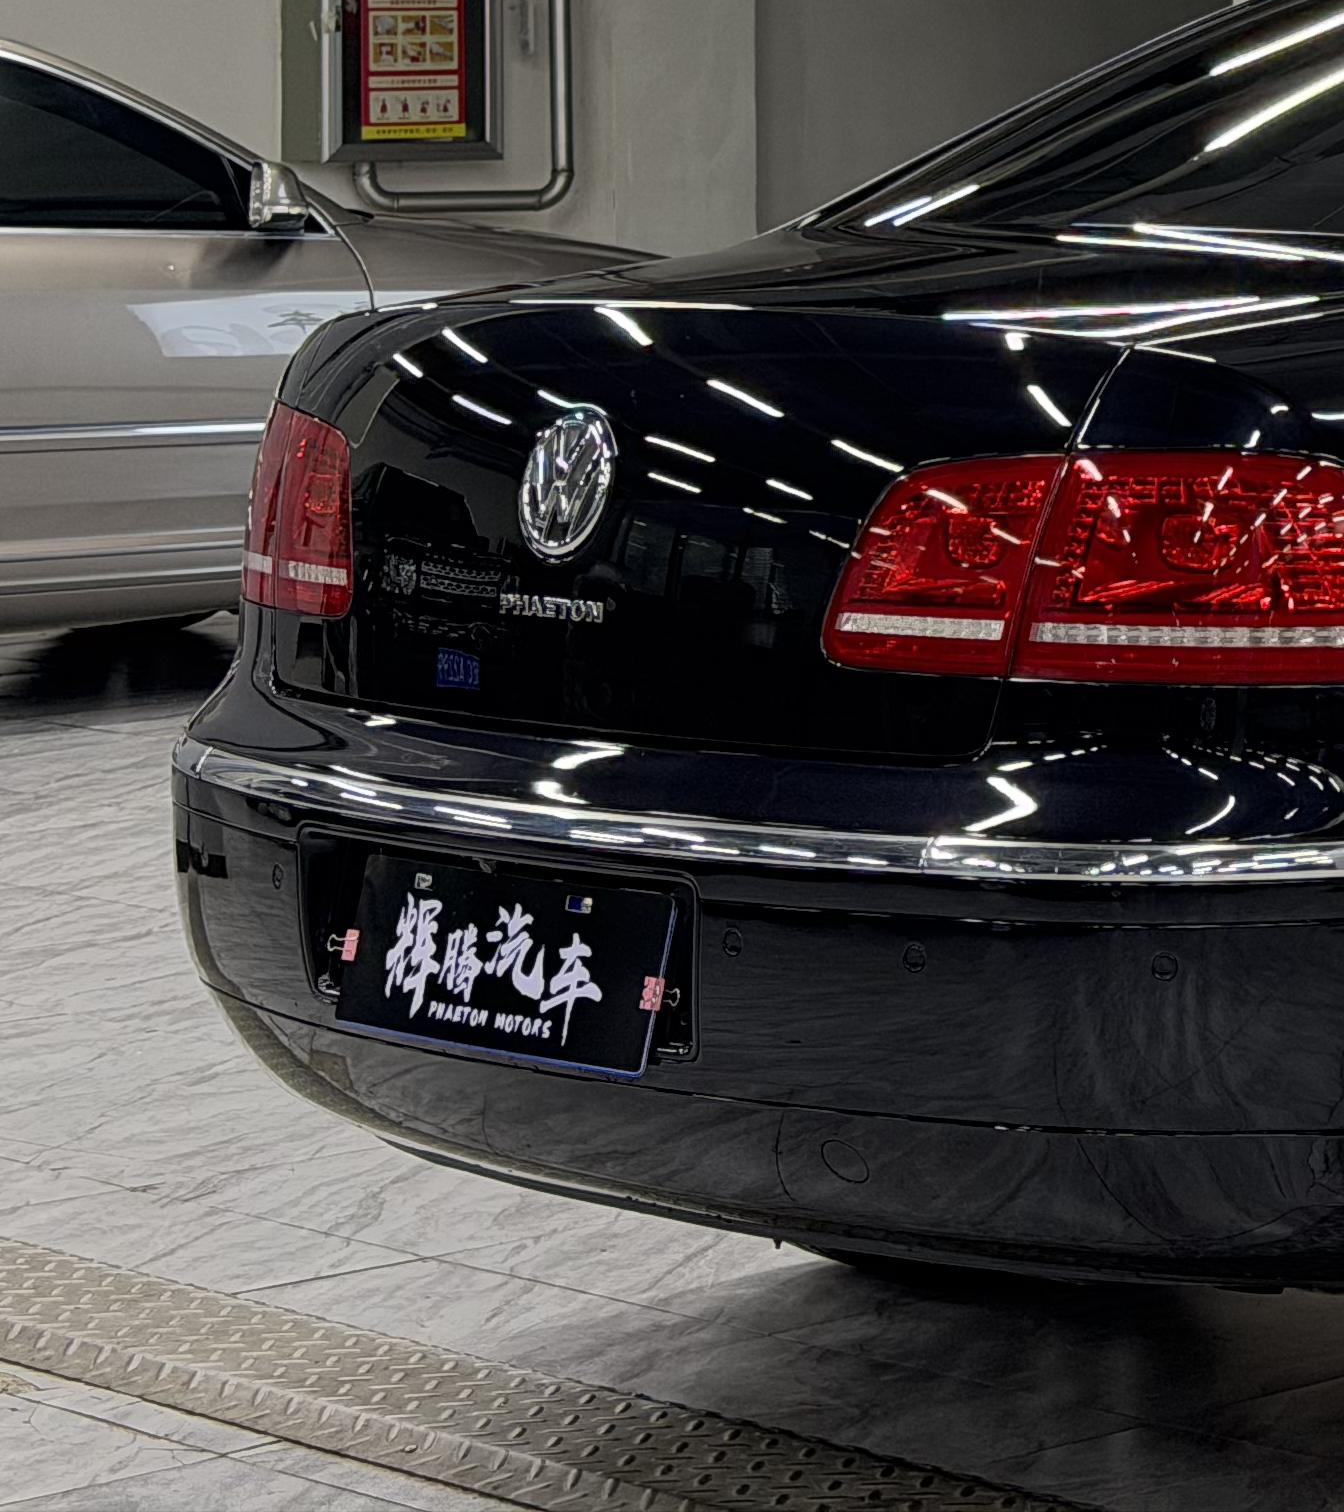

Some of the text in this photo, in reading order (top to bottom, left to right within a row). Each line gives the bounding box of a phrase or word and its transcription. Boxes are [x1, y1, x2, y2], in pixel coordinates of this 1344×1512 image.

[499, 593, 604, 624] PHAETON
[427, 1000, 553, 1039] PHAETON MOTORS
